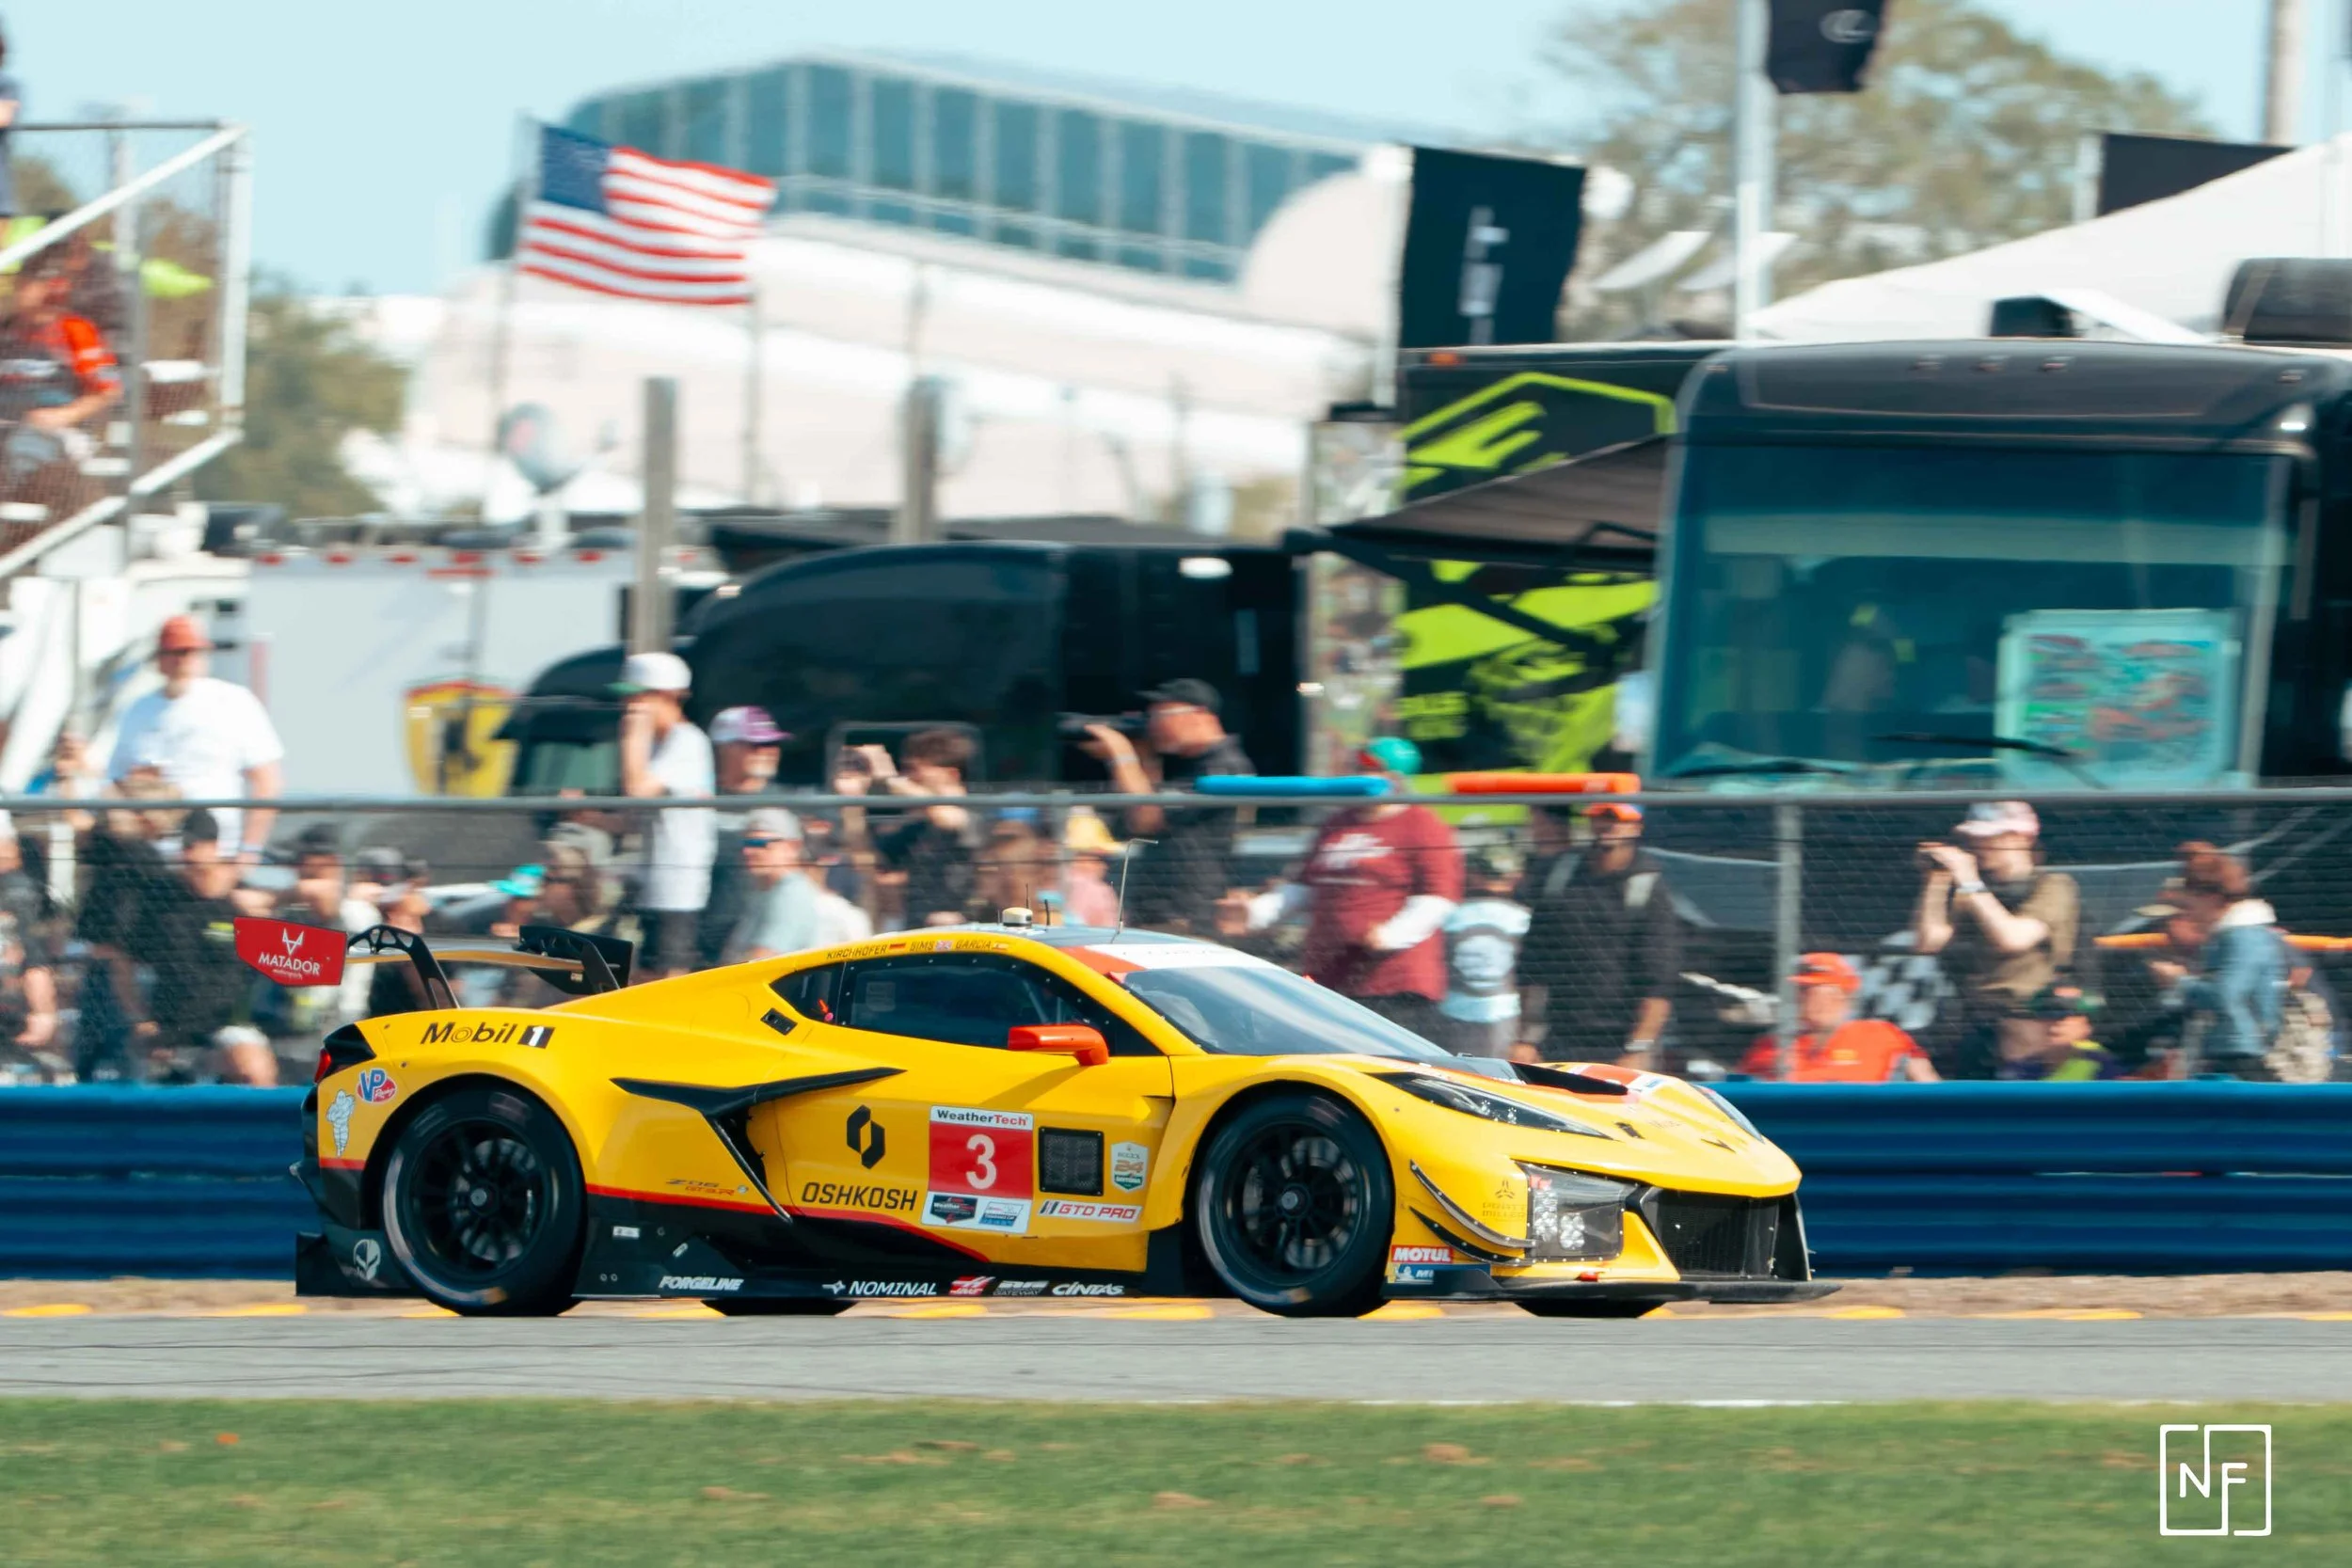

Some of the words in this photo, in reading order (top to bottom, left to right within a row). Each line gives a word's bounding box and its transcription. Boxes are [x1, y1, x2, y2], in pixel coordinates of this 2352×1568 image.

[826, 944, 887, 959] KIRCHHOFER
[910, 941, 934, 952] SIMS
[956, 939, 991, 949] GARCIA
[258, 951, 321, 974] MATADOR
[420, 1022, 517, 1044] Mobil
[359, 1068, 387, 1102] VP
[937, 1109, 1027, 1127] WeatherTech
[965, 1133, 997, 1190] 3
[802, 1181, 918, 1211] OSHKOSH
[1058, 1203, 1096, 1217] GTD
[1098, 1207, 1136, 1220] PRO
[1392, 1246, 1451, 1262] MOTUL
[659, 1275, 744, 1291] FORGELINE
[849, 1276, 937, 1295] NOMINAL
